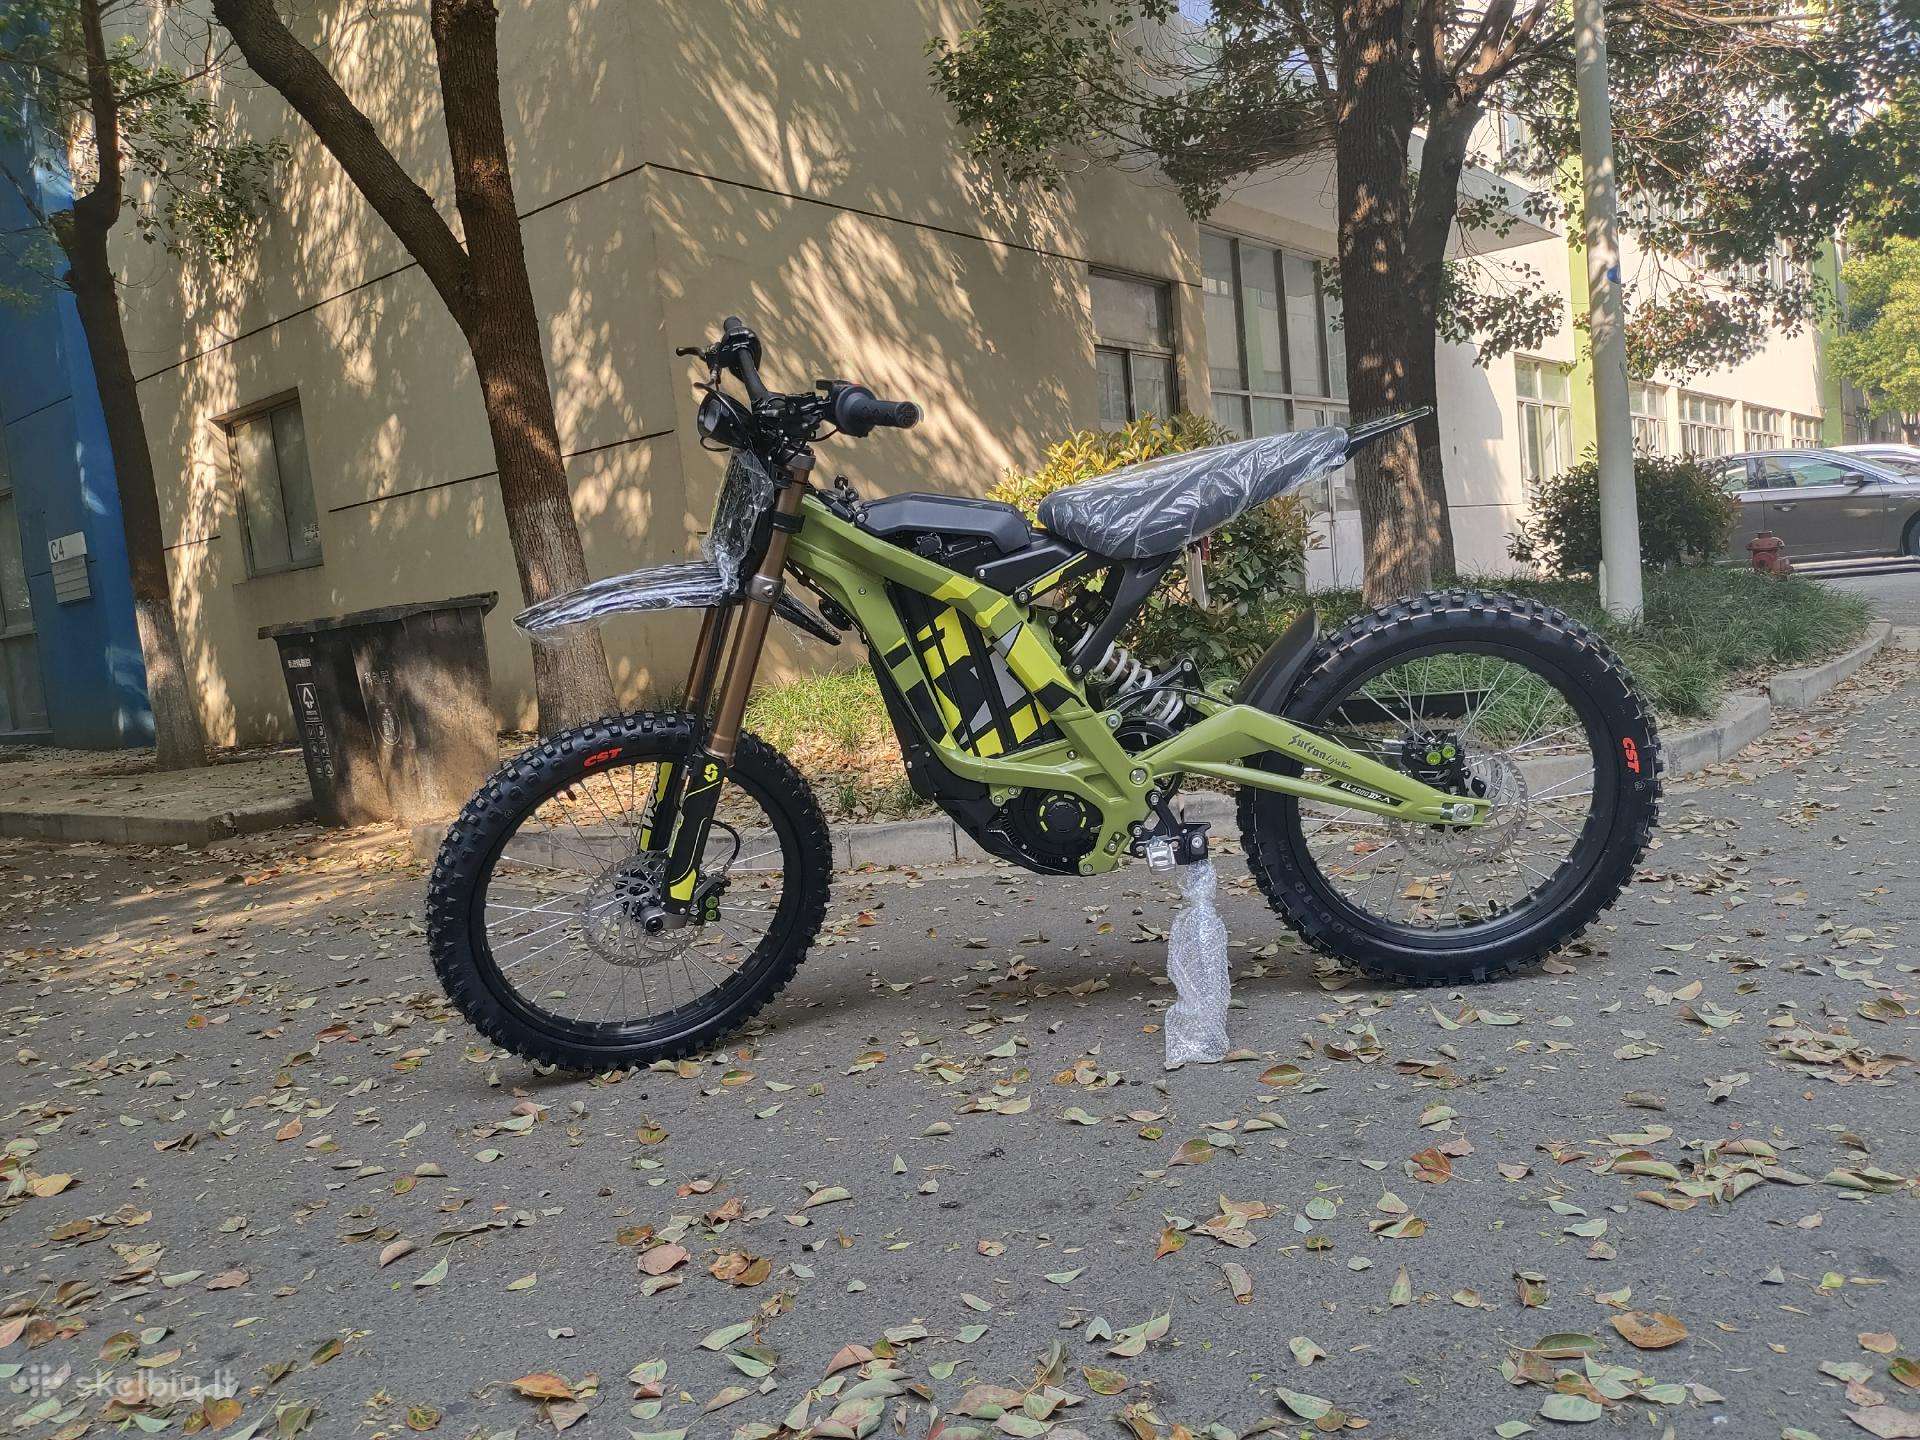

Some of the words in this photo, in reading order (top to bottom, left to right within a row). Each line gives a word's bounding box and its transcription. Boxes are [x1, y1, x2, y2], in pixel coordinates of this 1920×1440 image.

[50, 539, 65, 561] C4
[583, 748, 622, 767] CST
[1622, 737, 1640, 773] CST
